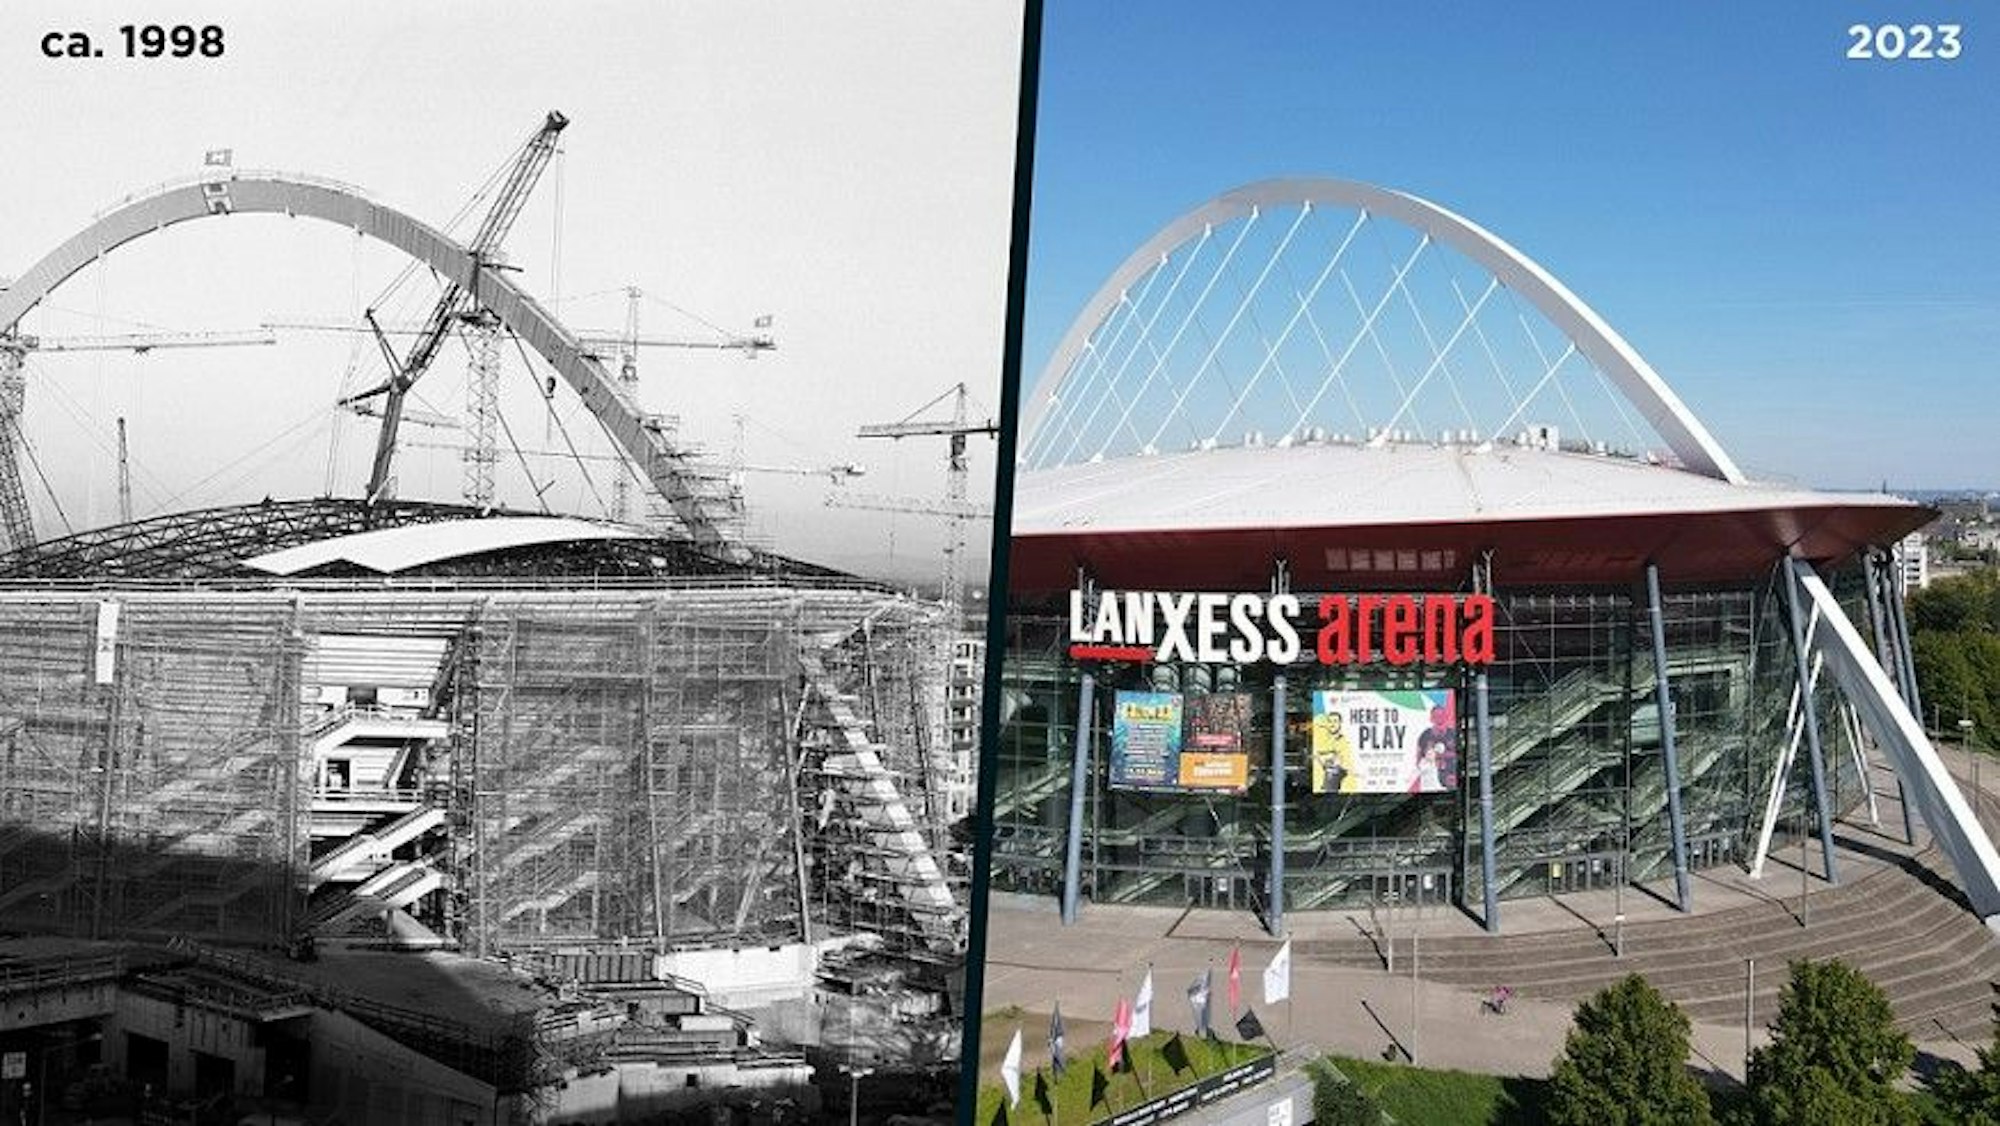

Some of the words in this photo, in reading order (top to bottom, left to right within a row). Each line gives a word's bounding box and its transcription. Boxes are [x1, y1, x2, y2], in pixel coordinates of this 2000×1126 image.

[1069, 589, 1301, 664] LANXESS
[1317, 593, 1496, 666] arena
[1350, 708, 1380, 724] HERE
[1384, 708, 1399, 724] TO
[1359, 725, 1406, 749] PLAY
